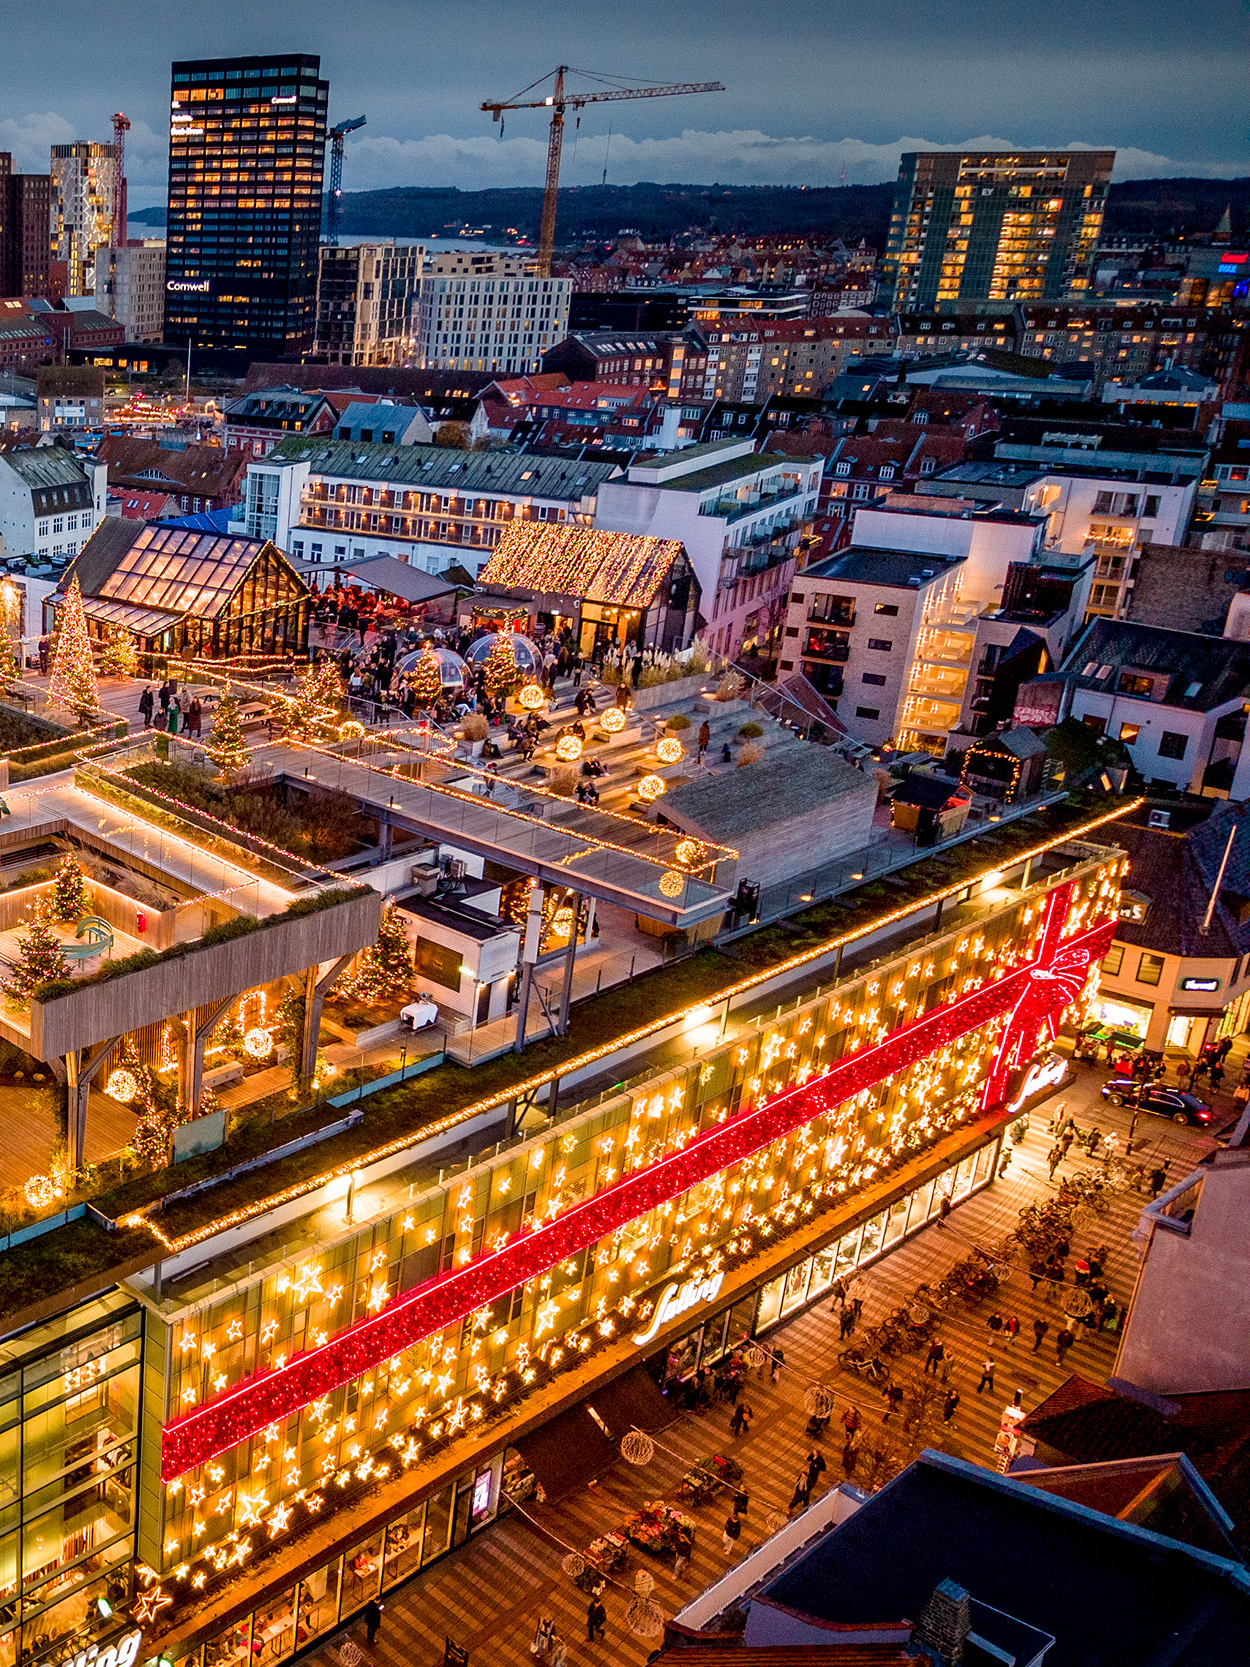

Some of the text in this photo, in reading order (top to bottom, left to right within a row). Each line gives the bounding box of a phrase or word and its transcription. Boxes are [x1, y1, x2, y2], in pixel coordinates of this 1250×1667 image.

[981, 188, 994, 196] EY
[166, 280, 210, 292] Comwell
[631, 1270, 725, 1346] Salling
